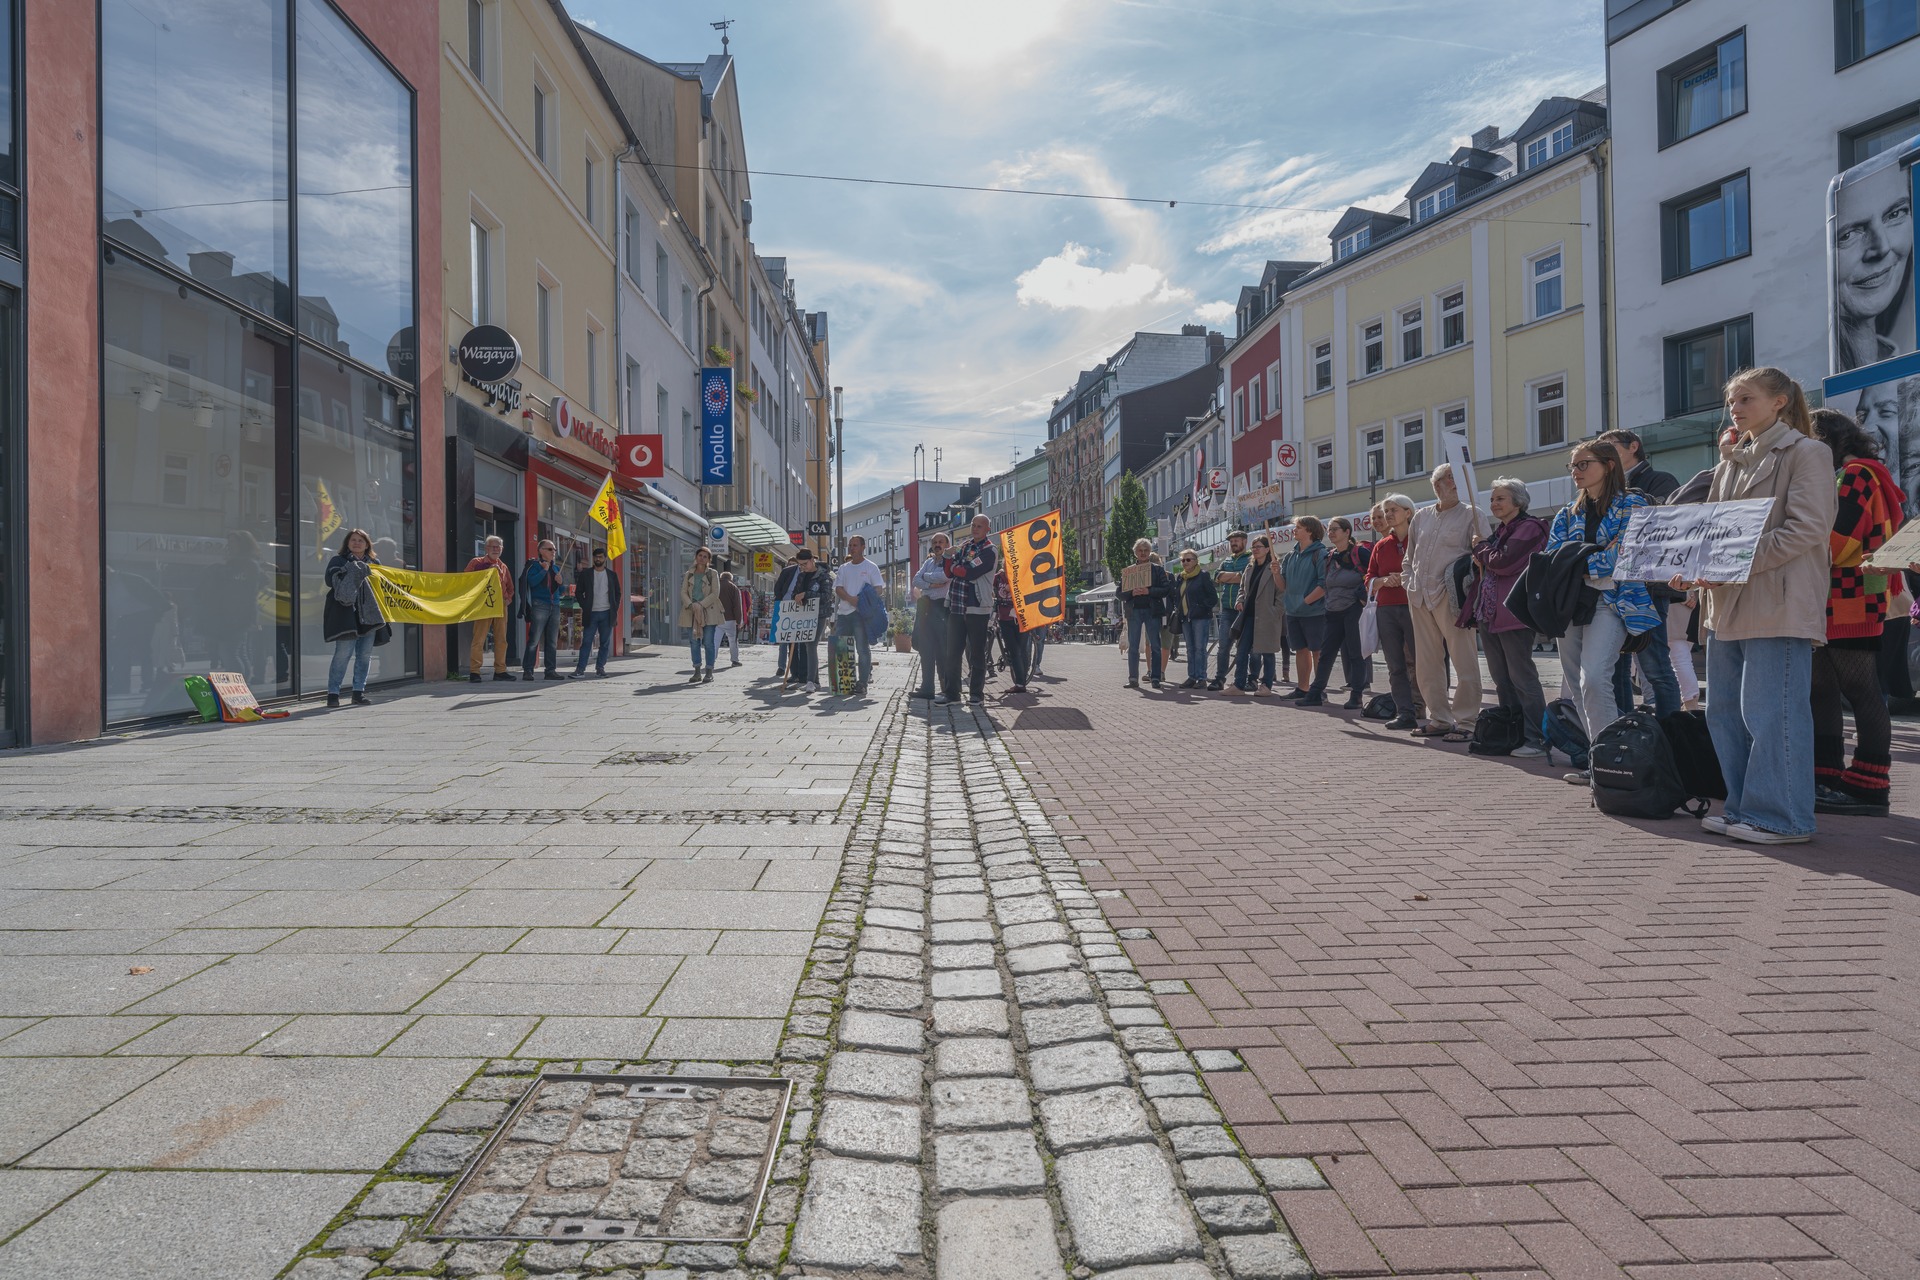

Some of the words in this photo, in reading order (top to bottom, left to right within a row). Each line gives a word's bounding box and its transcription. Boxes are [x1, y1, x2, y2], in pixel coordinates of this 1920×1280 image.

[461, 345, 515, 364] Wagaya
[710, 424, 727, 477] Apollo
[811, 524, 827, 533] C&A
[1656, 546, 1693, 568] Eis!
[1023, 519, 1063, 618] ödp
[782, 602, 799, 613] LIKE
[781, 616, 818, 631] Oceans
[1018, 609, 1029, 628] Partei
[780, 631, 792, 641] WE
[796, 629, 813, 641] RISE
